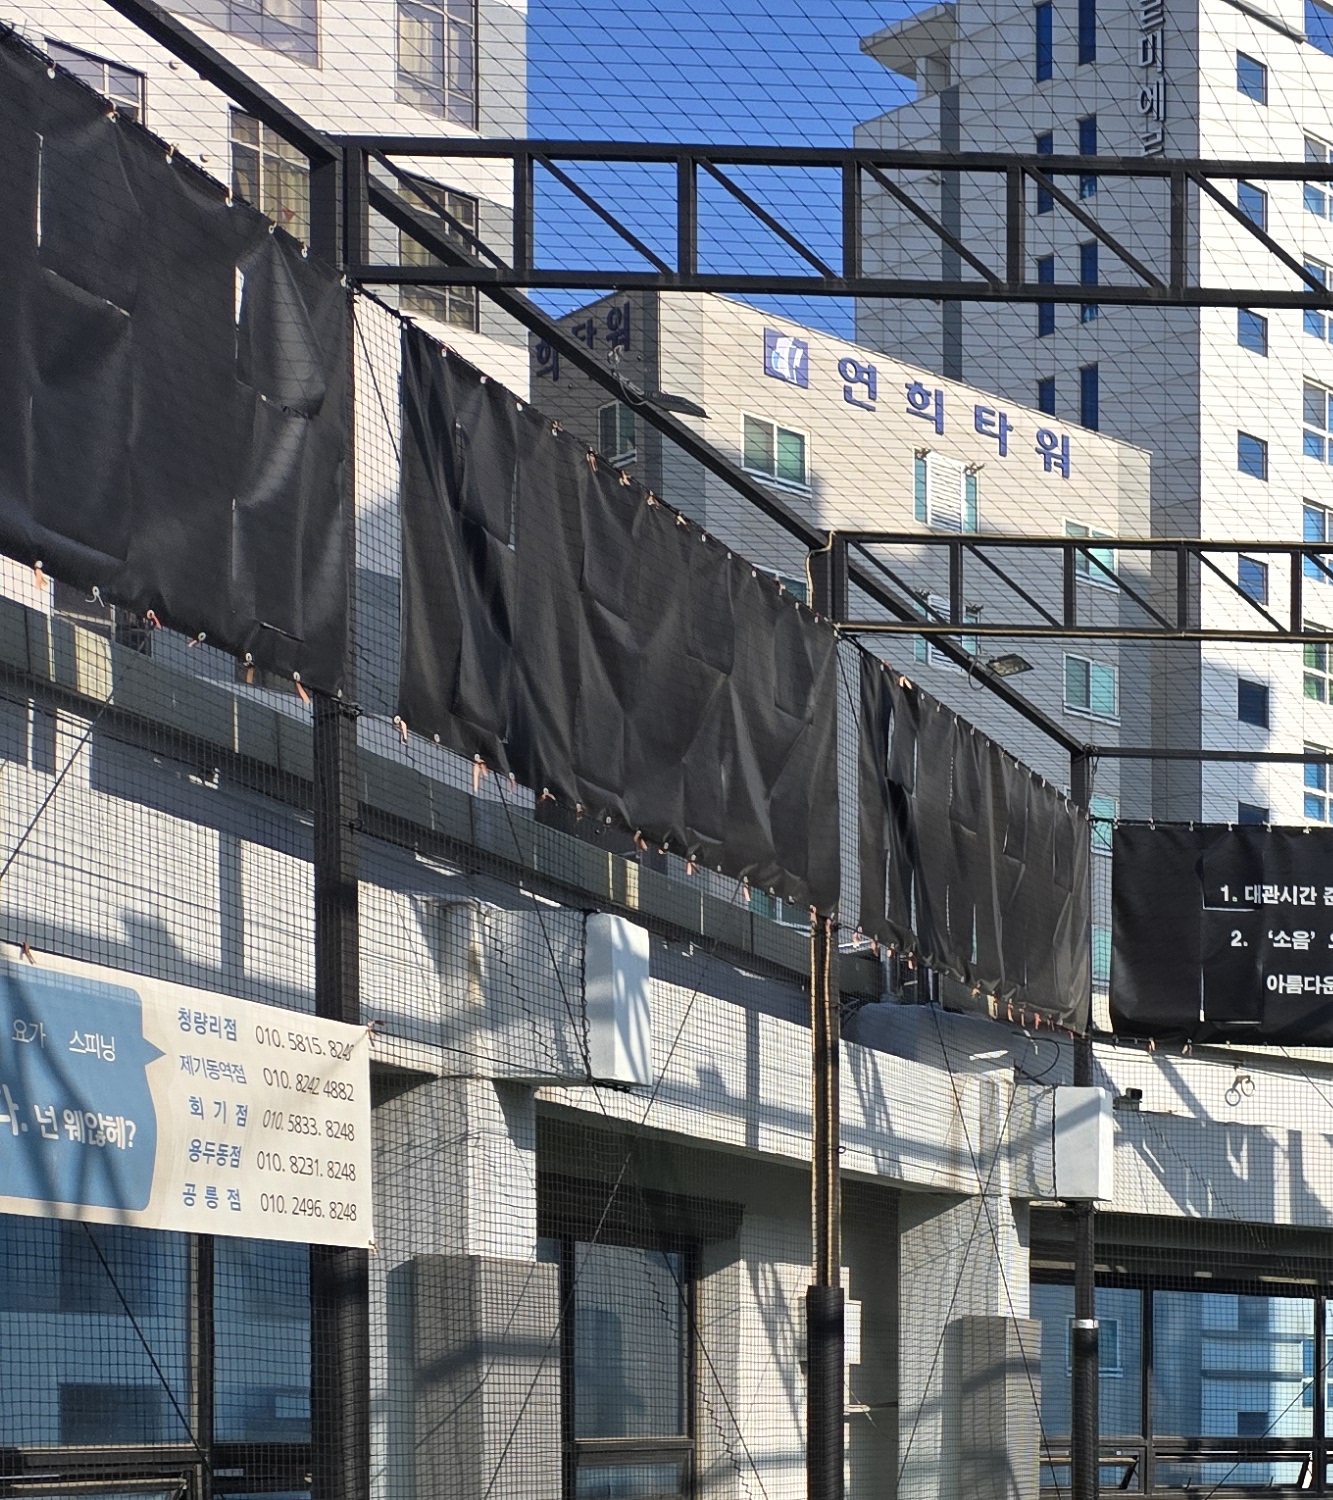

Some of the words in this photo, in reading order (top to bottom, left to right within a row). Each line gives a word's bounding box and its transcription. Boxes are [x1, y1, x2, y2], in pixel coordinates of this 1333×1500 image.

[838, 357, 1070, 479] 연희타워
[1220, 885, 1238, 902] 1.
[1244, 884, 1318, 905] 대관시간
[1230, 930, 1248, 947] 2.
[12, 1019, 46, 1048] 요가
[69, 1030, 116, 1062] 스피닝
[178, 1007, 237, 1041] 청량리점
[255, 1025, 285, 1048] 010.
[288, 1032, 326, 1056] 5815.
[179, 1054, 248, 1085] 제기동역점
[263, 1067, 292, 1090] 010.
[323, 1080, 354, 1101] 4882
[34, 1104, 59, 1140] 넌
[262, 1109, 284, 1131] 010.
[287, 1113, 322, 1137] 5833.
[325, 1120, 355, 1141] 8248
[189, 1138, 242, 1169] 용두동점
[256, 1151, 286, 1173] 010.
[289, 1155, 323, 1177] 8231.
[327, 1161, 356, 1182] 8248
[260, 1193, 287, 1214] 010.
[291, 1197, 325, 1219] 2496.
[329, 1201, 357, 1222] 8248
